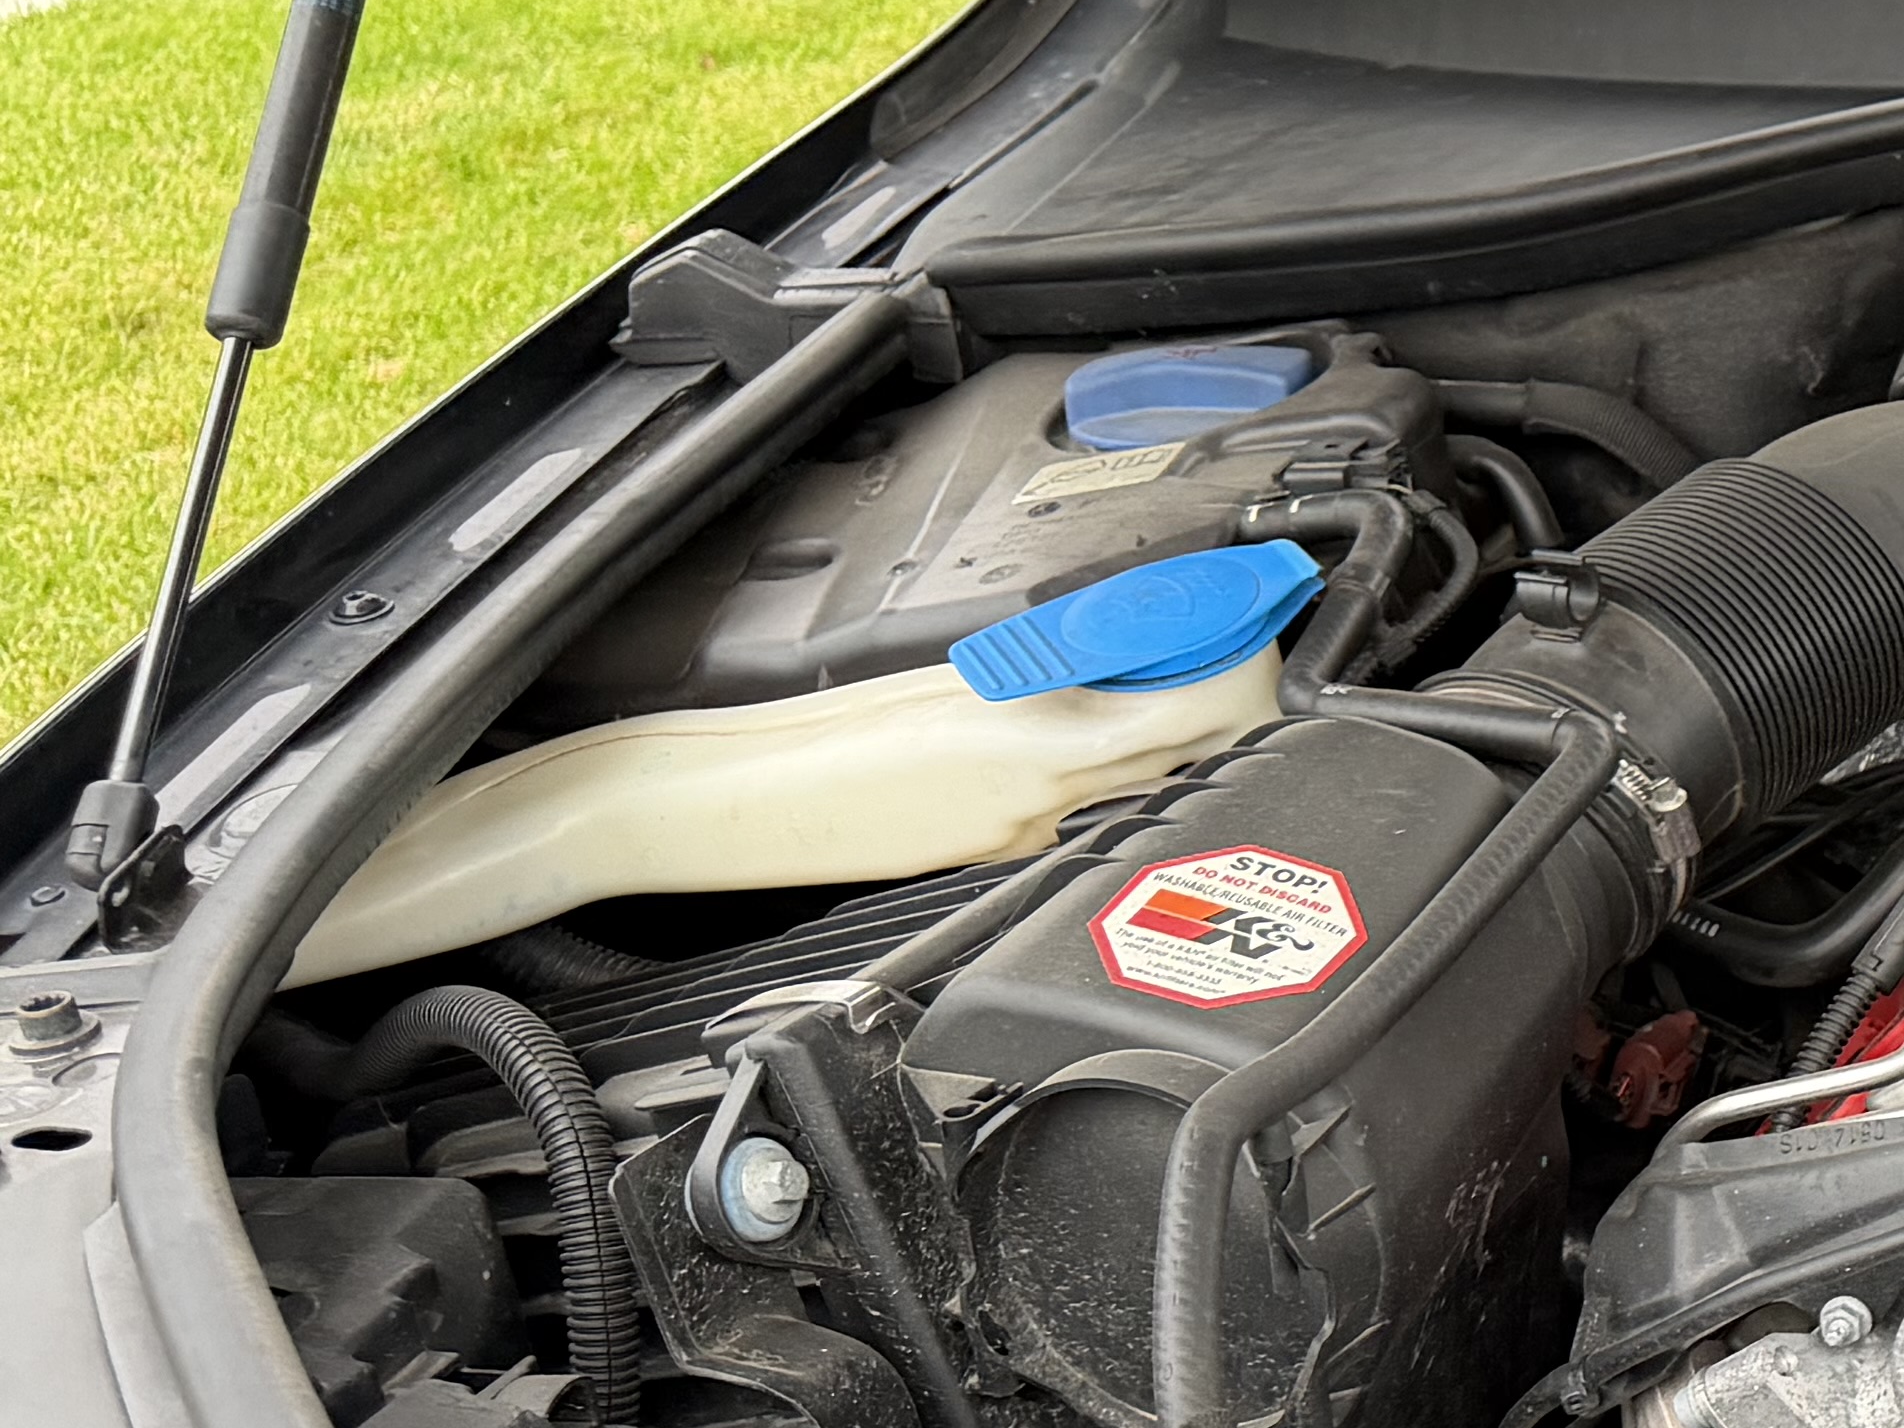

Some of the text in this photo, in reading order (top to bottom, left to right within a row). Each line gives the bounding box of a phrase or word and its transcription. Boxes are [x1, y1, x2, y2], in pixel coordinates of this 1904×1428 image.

[1192, 866, 1333, 914] DO NOT DISCARD
[1229, 855, 1329, 894] STOP!
[1153, 871, 1349, 938] WASHABLE/REUSABLE AIR FILTER
